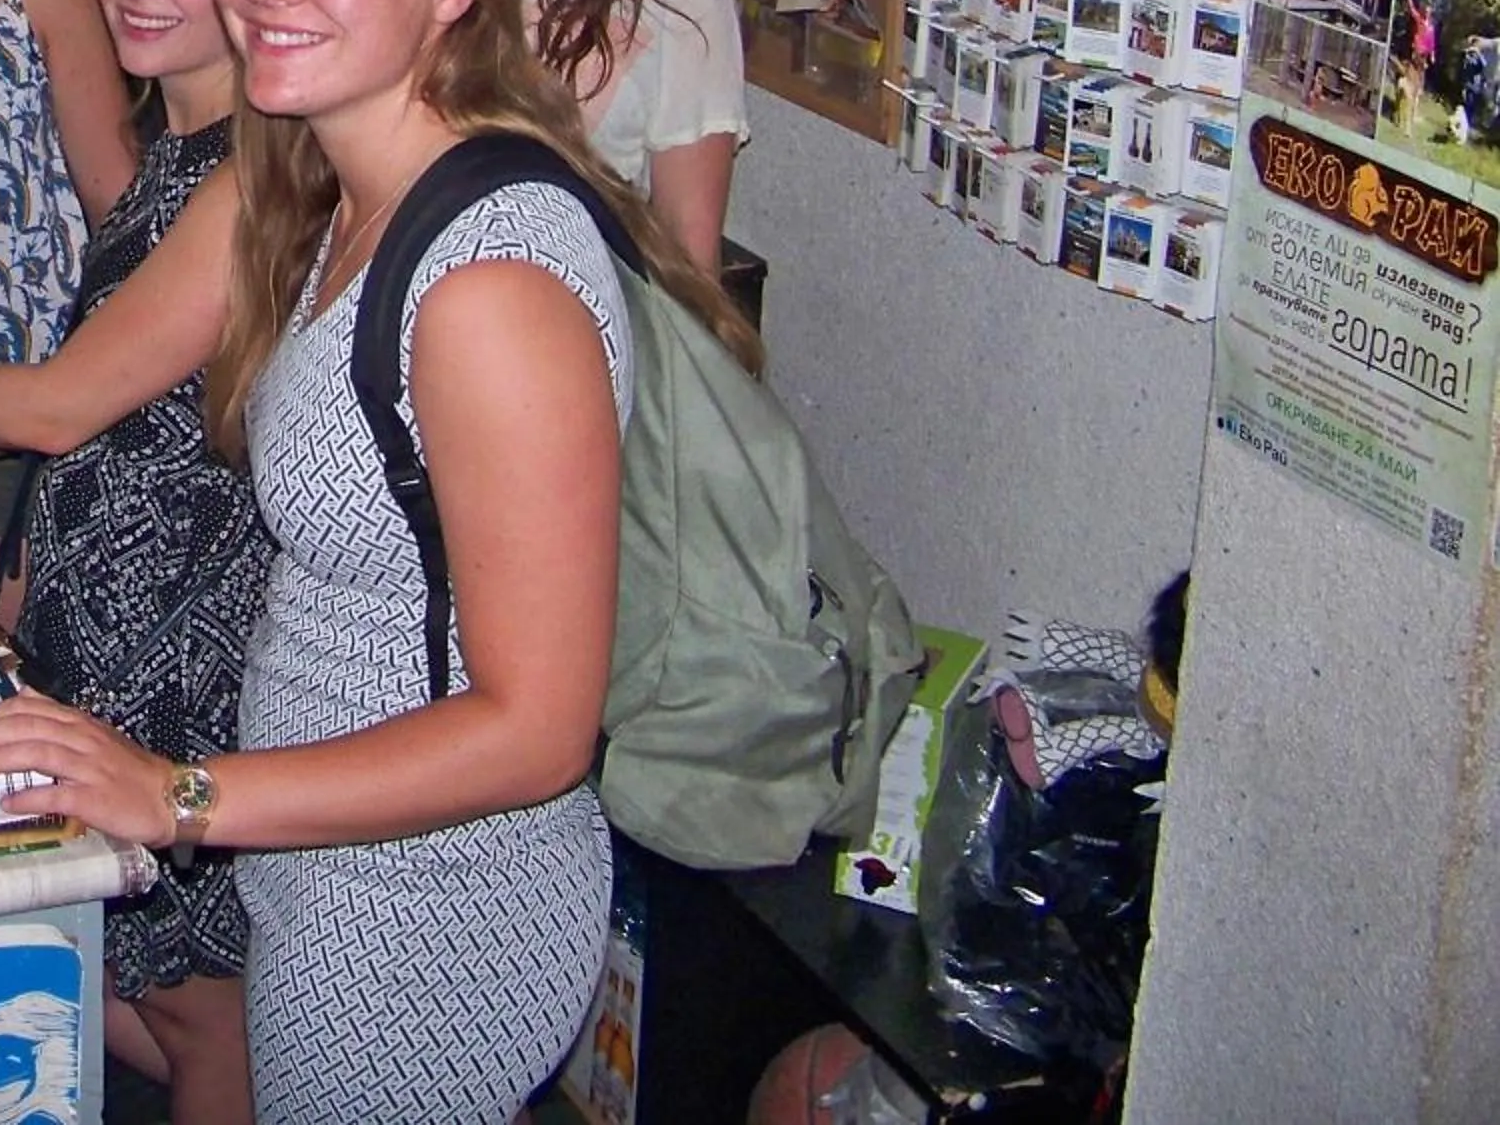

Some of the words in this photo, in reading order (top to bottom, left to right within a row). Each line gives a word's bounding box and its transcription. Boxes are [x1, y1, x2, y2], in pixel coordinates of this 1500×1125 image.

[1264, 133, 1345, 211] ЕКО
[1266, 391, 1352, 451] ОТКРИВАНЕ
[1353, 439, 1375, 461] 24
[1377, 451, 1420, 485] МАЙ
